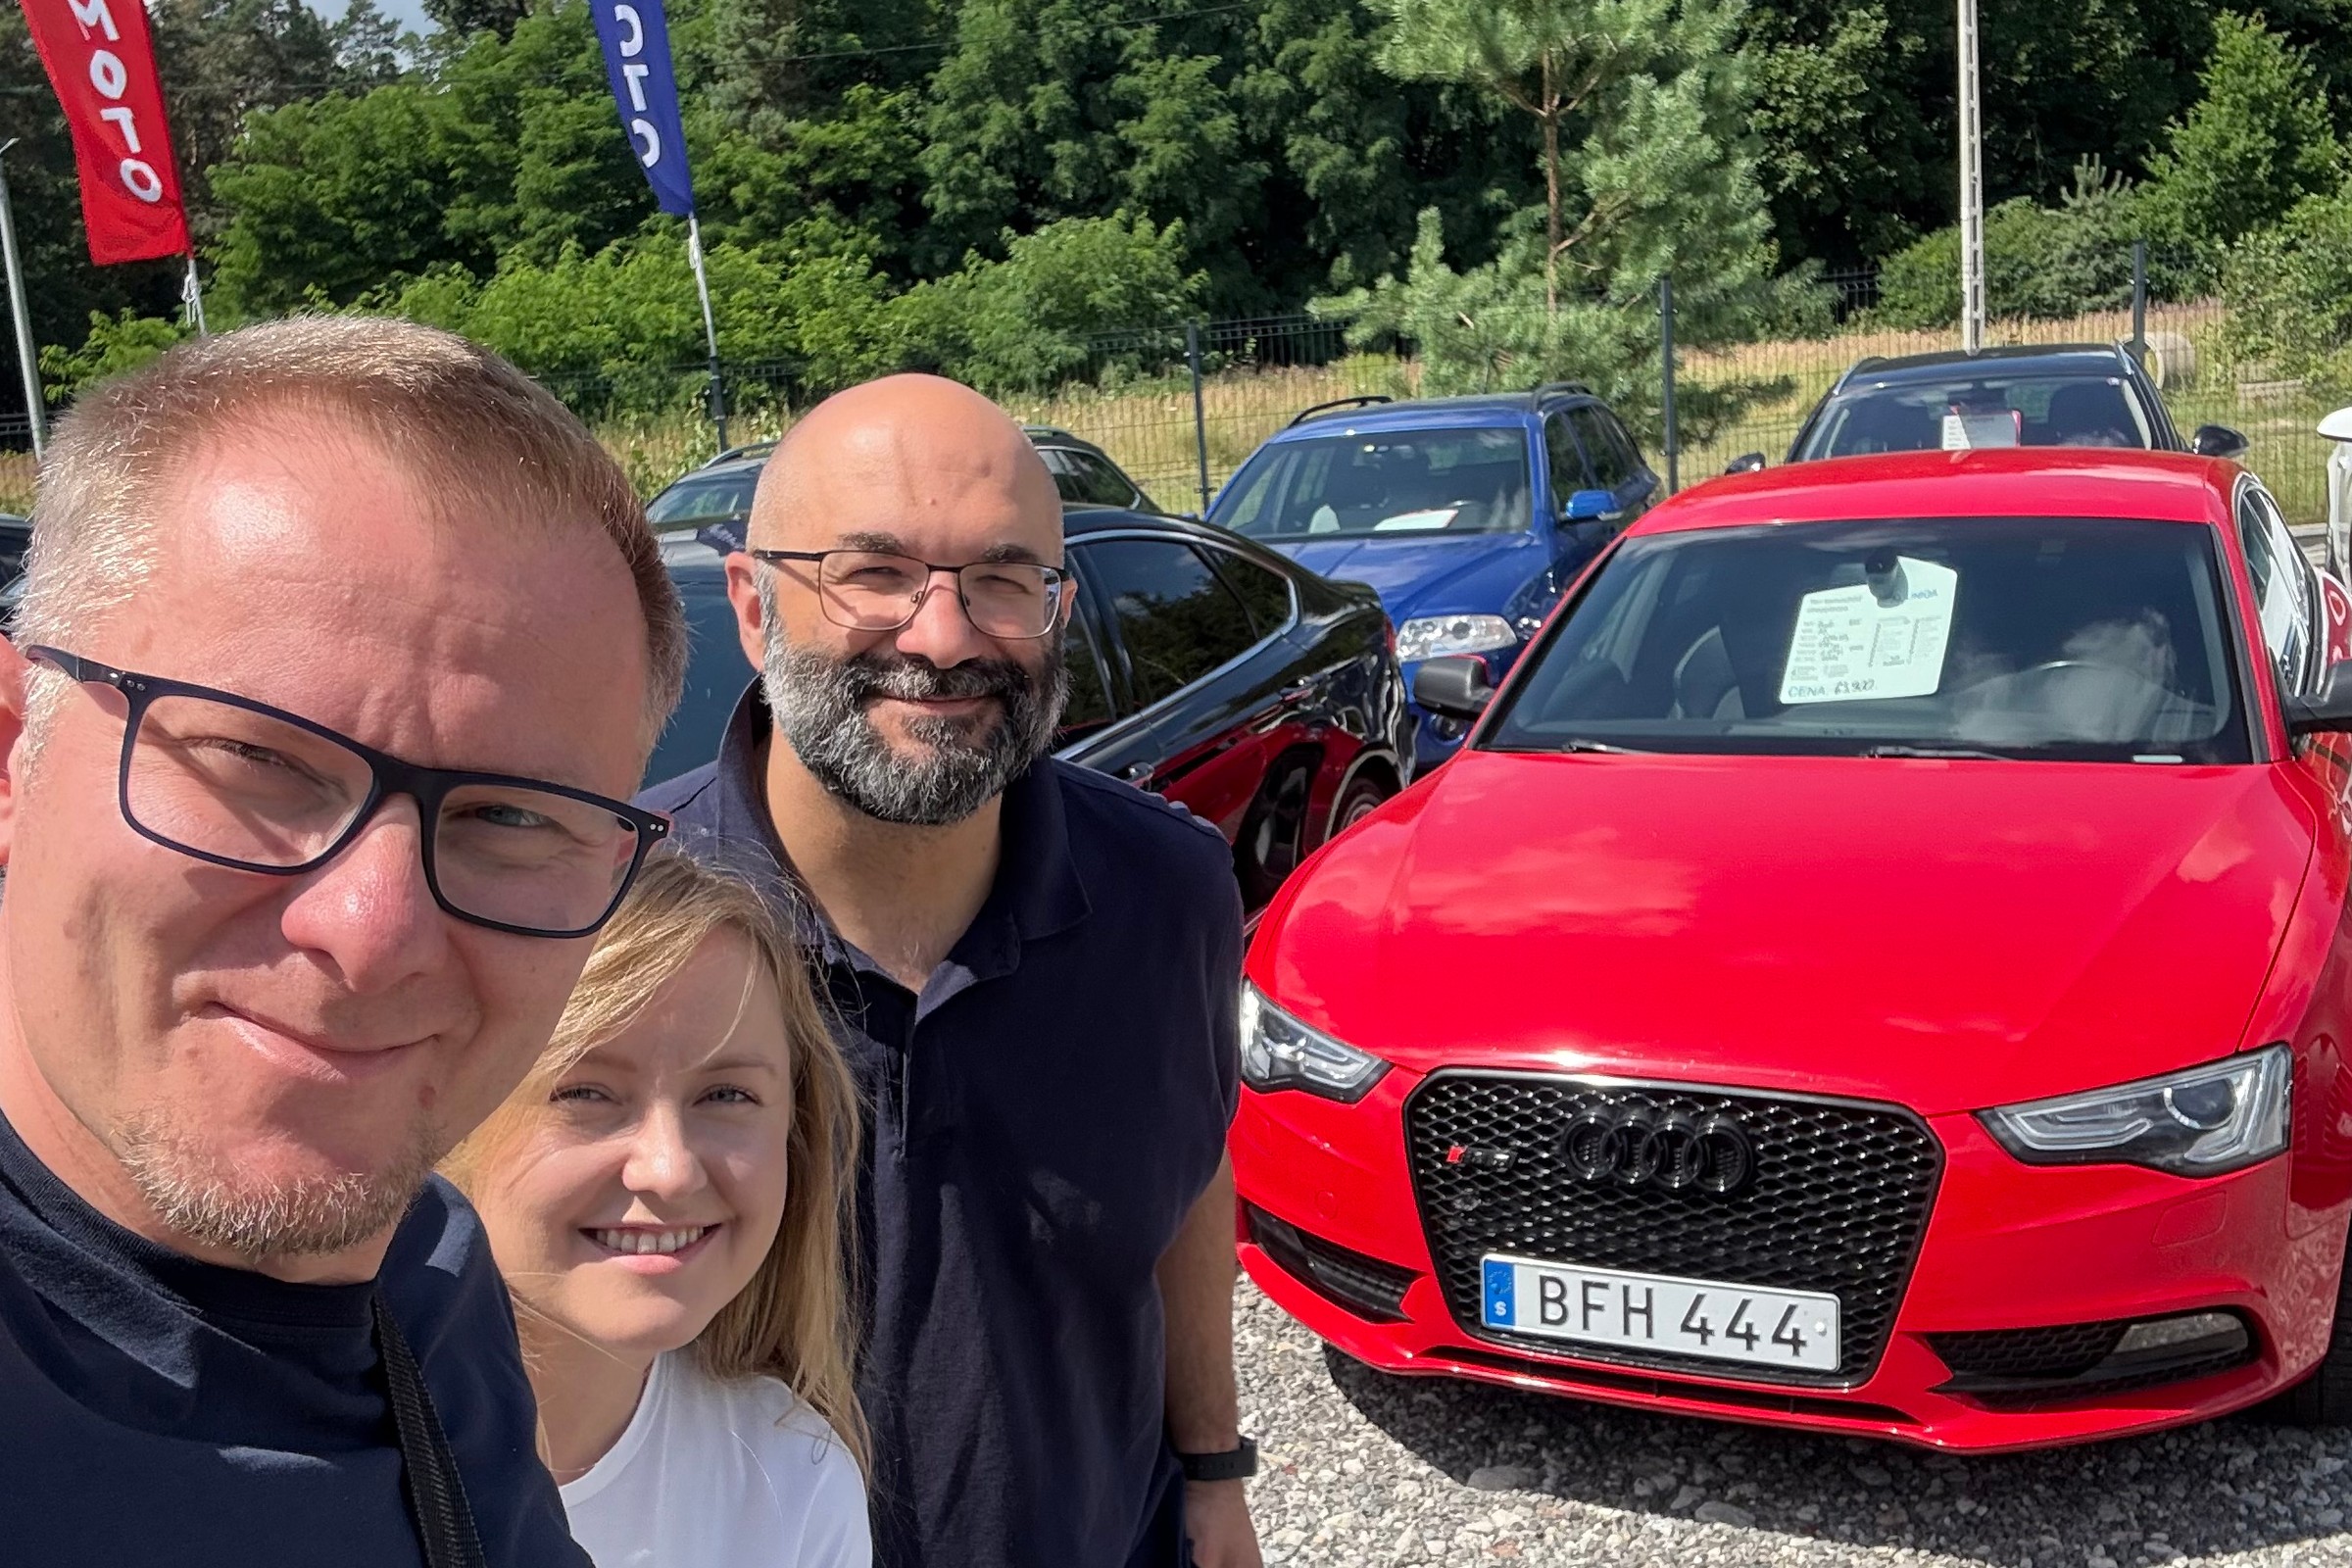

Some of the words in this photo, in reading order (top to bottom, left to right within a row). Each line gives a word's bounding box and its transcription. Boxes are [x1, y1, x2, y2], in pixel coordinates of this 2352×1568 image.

[68, 0, 163, 203] MOTO
[1494, 1300, 1507, 1317] S
[1539, 1274, 1654, 1340] BFH
[1679, 1292, 1808, 1357] 444
